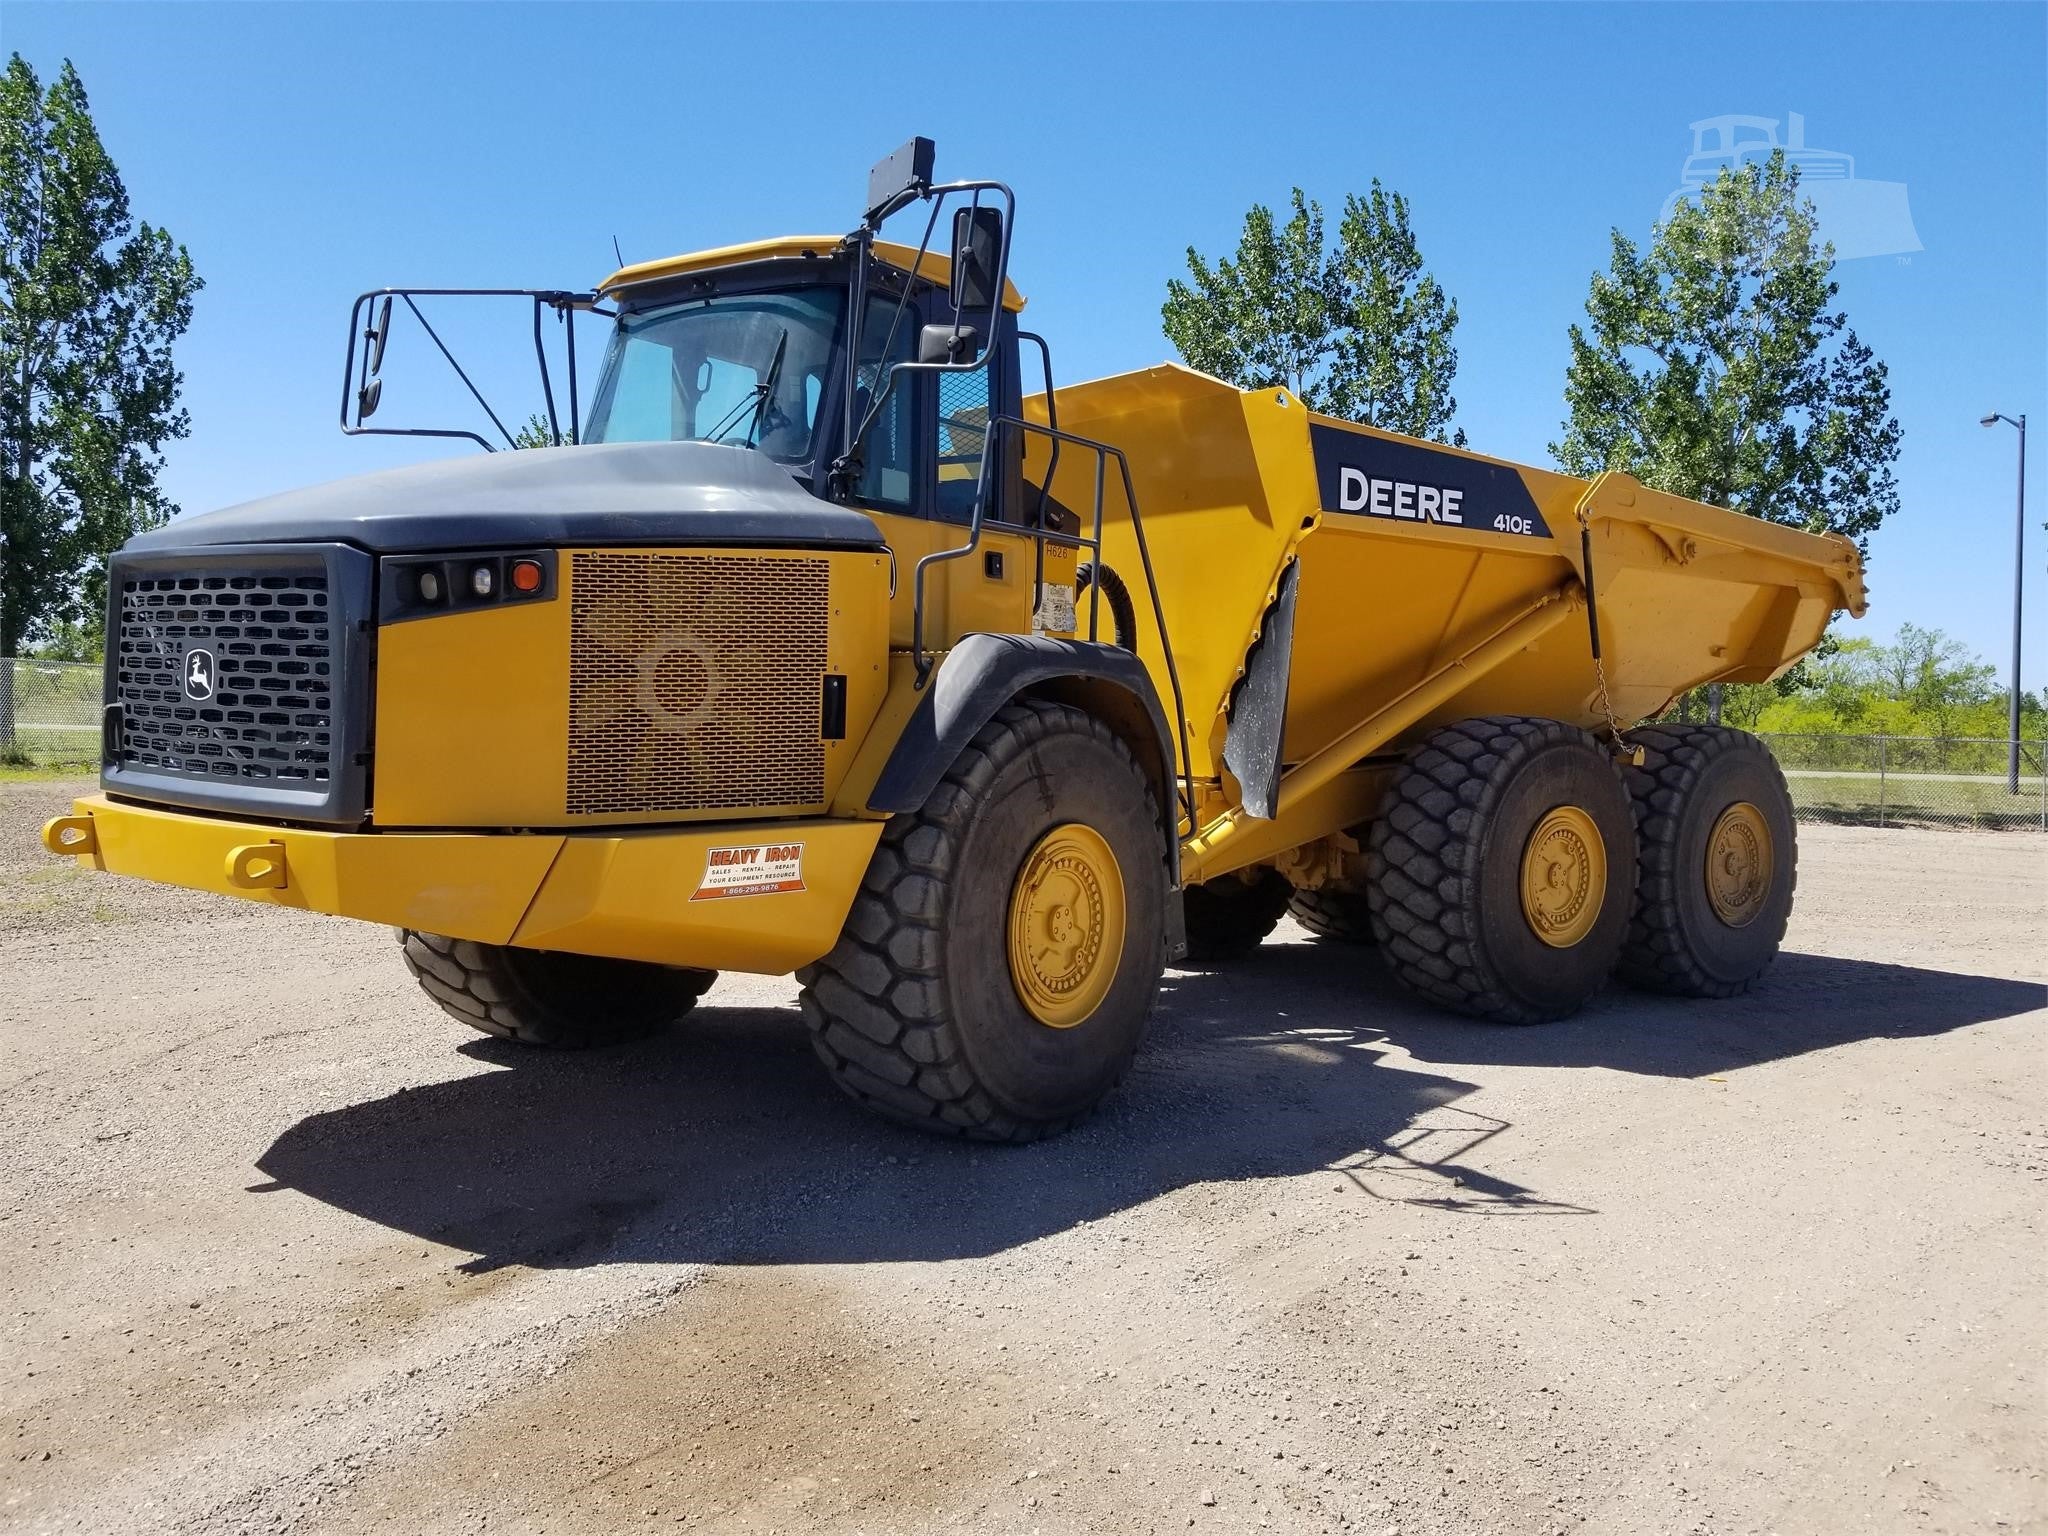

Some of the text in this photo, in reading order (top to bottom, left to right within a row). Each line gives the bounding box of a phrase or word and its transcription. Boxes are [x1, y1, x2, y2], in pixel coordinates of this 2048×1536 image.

[1339, 466, 1464, 524] DEERE
[1493, 513, 1533, 535] 410E
[1046, 544, 1068, 558] H626
[710, 846, 800, 866] HEAVY IRON
[711, 868, 732, 876] SALES
[741, 865, 765, 873] RENTAL
[727, 874, 763, 883] EQUIPMENT
[764, 871, 796, 880] RESOURCE
